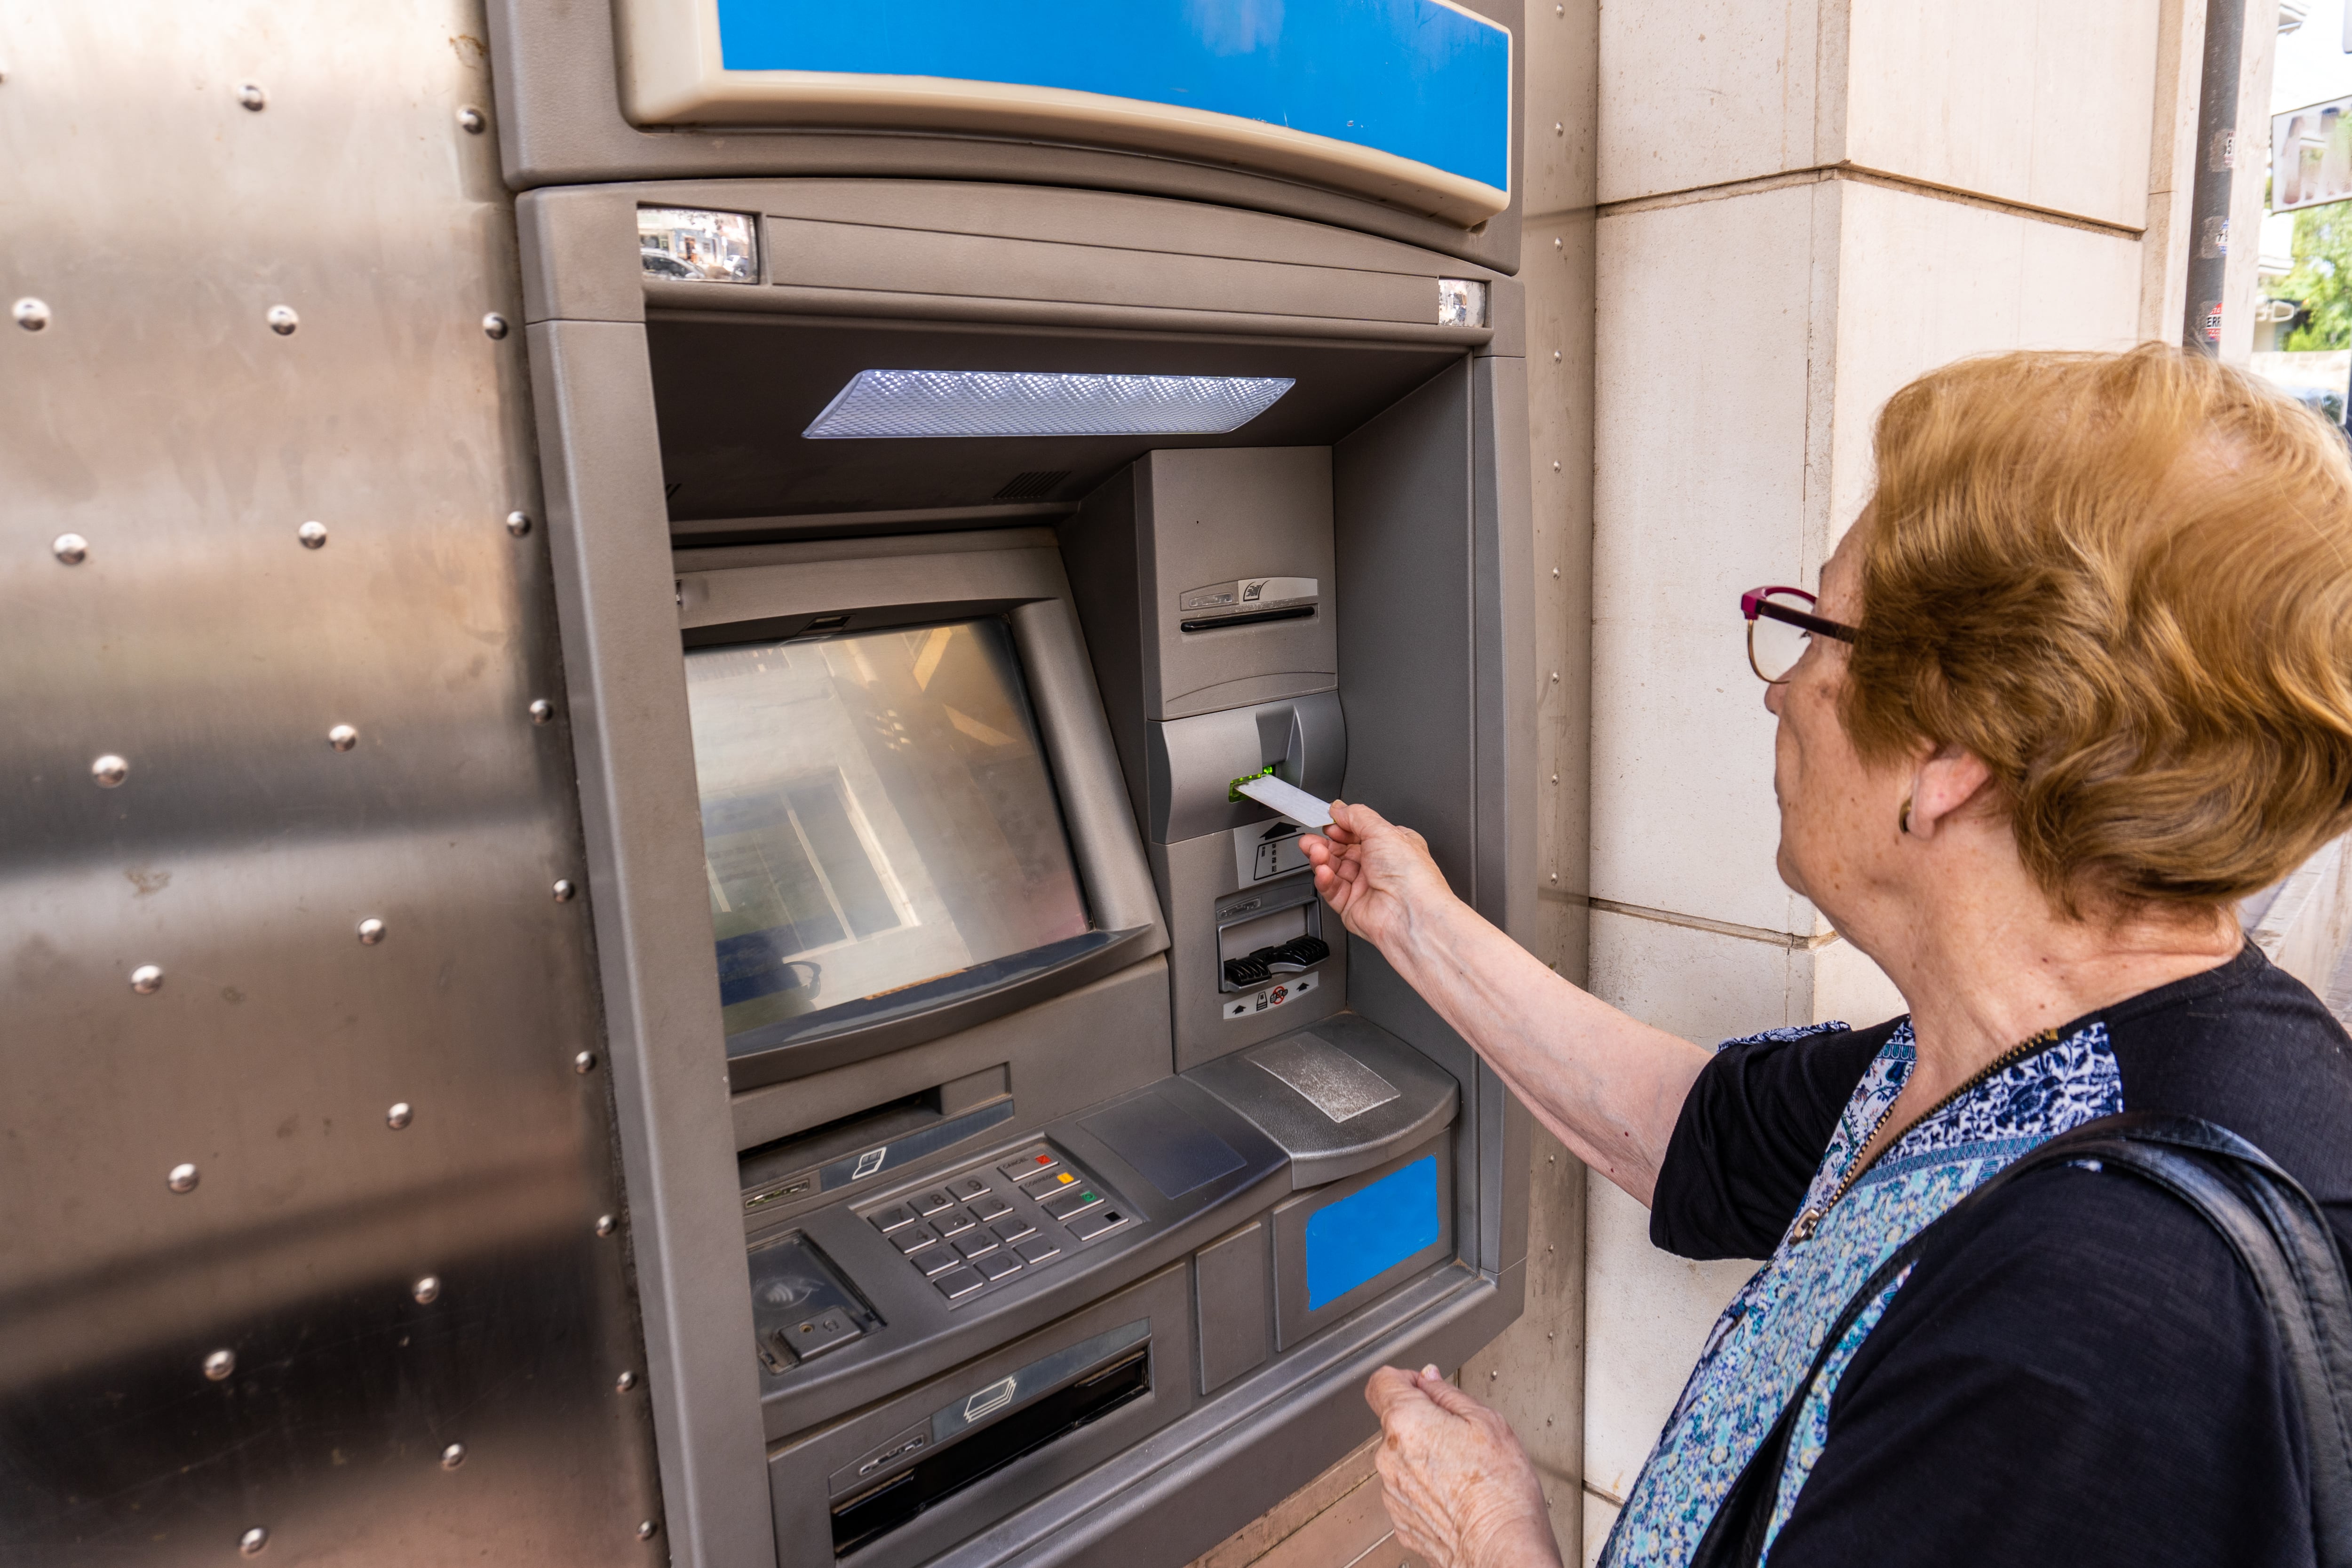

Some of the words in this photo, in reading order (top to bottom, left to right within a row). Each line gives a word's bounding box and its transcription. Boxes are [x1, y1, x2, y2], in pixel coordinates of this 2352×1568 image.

[967, 1180, 983, 1191] 9
[930, 1194, 946, 1205] 8
[990, 1198, 1005, 1210] 6
[890, 1208, 904, 1221] 7
[953, 1213, 968, 1226] 5
[1013, 1219, 1028, 1231] 3
[916, 1230, 929, 1240] 4
[975, 1234, 993, 1248] 2
